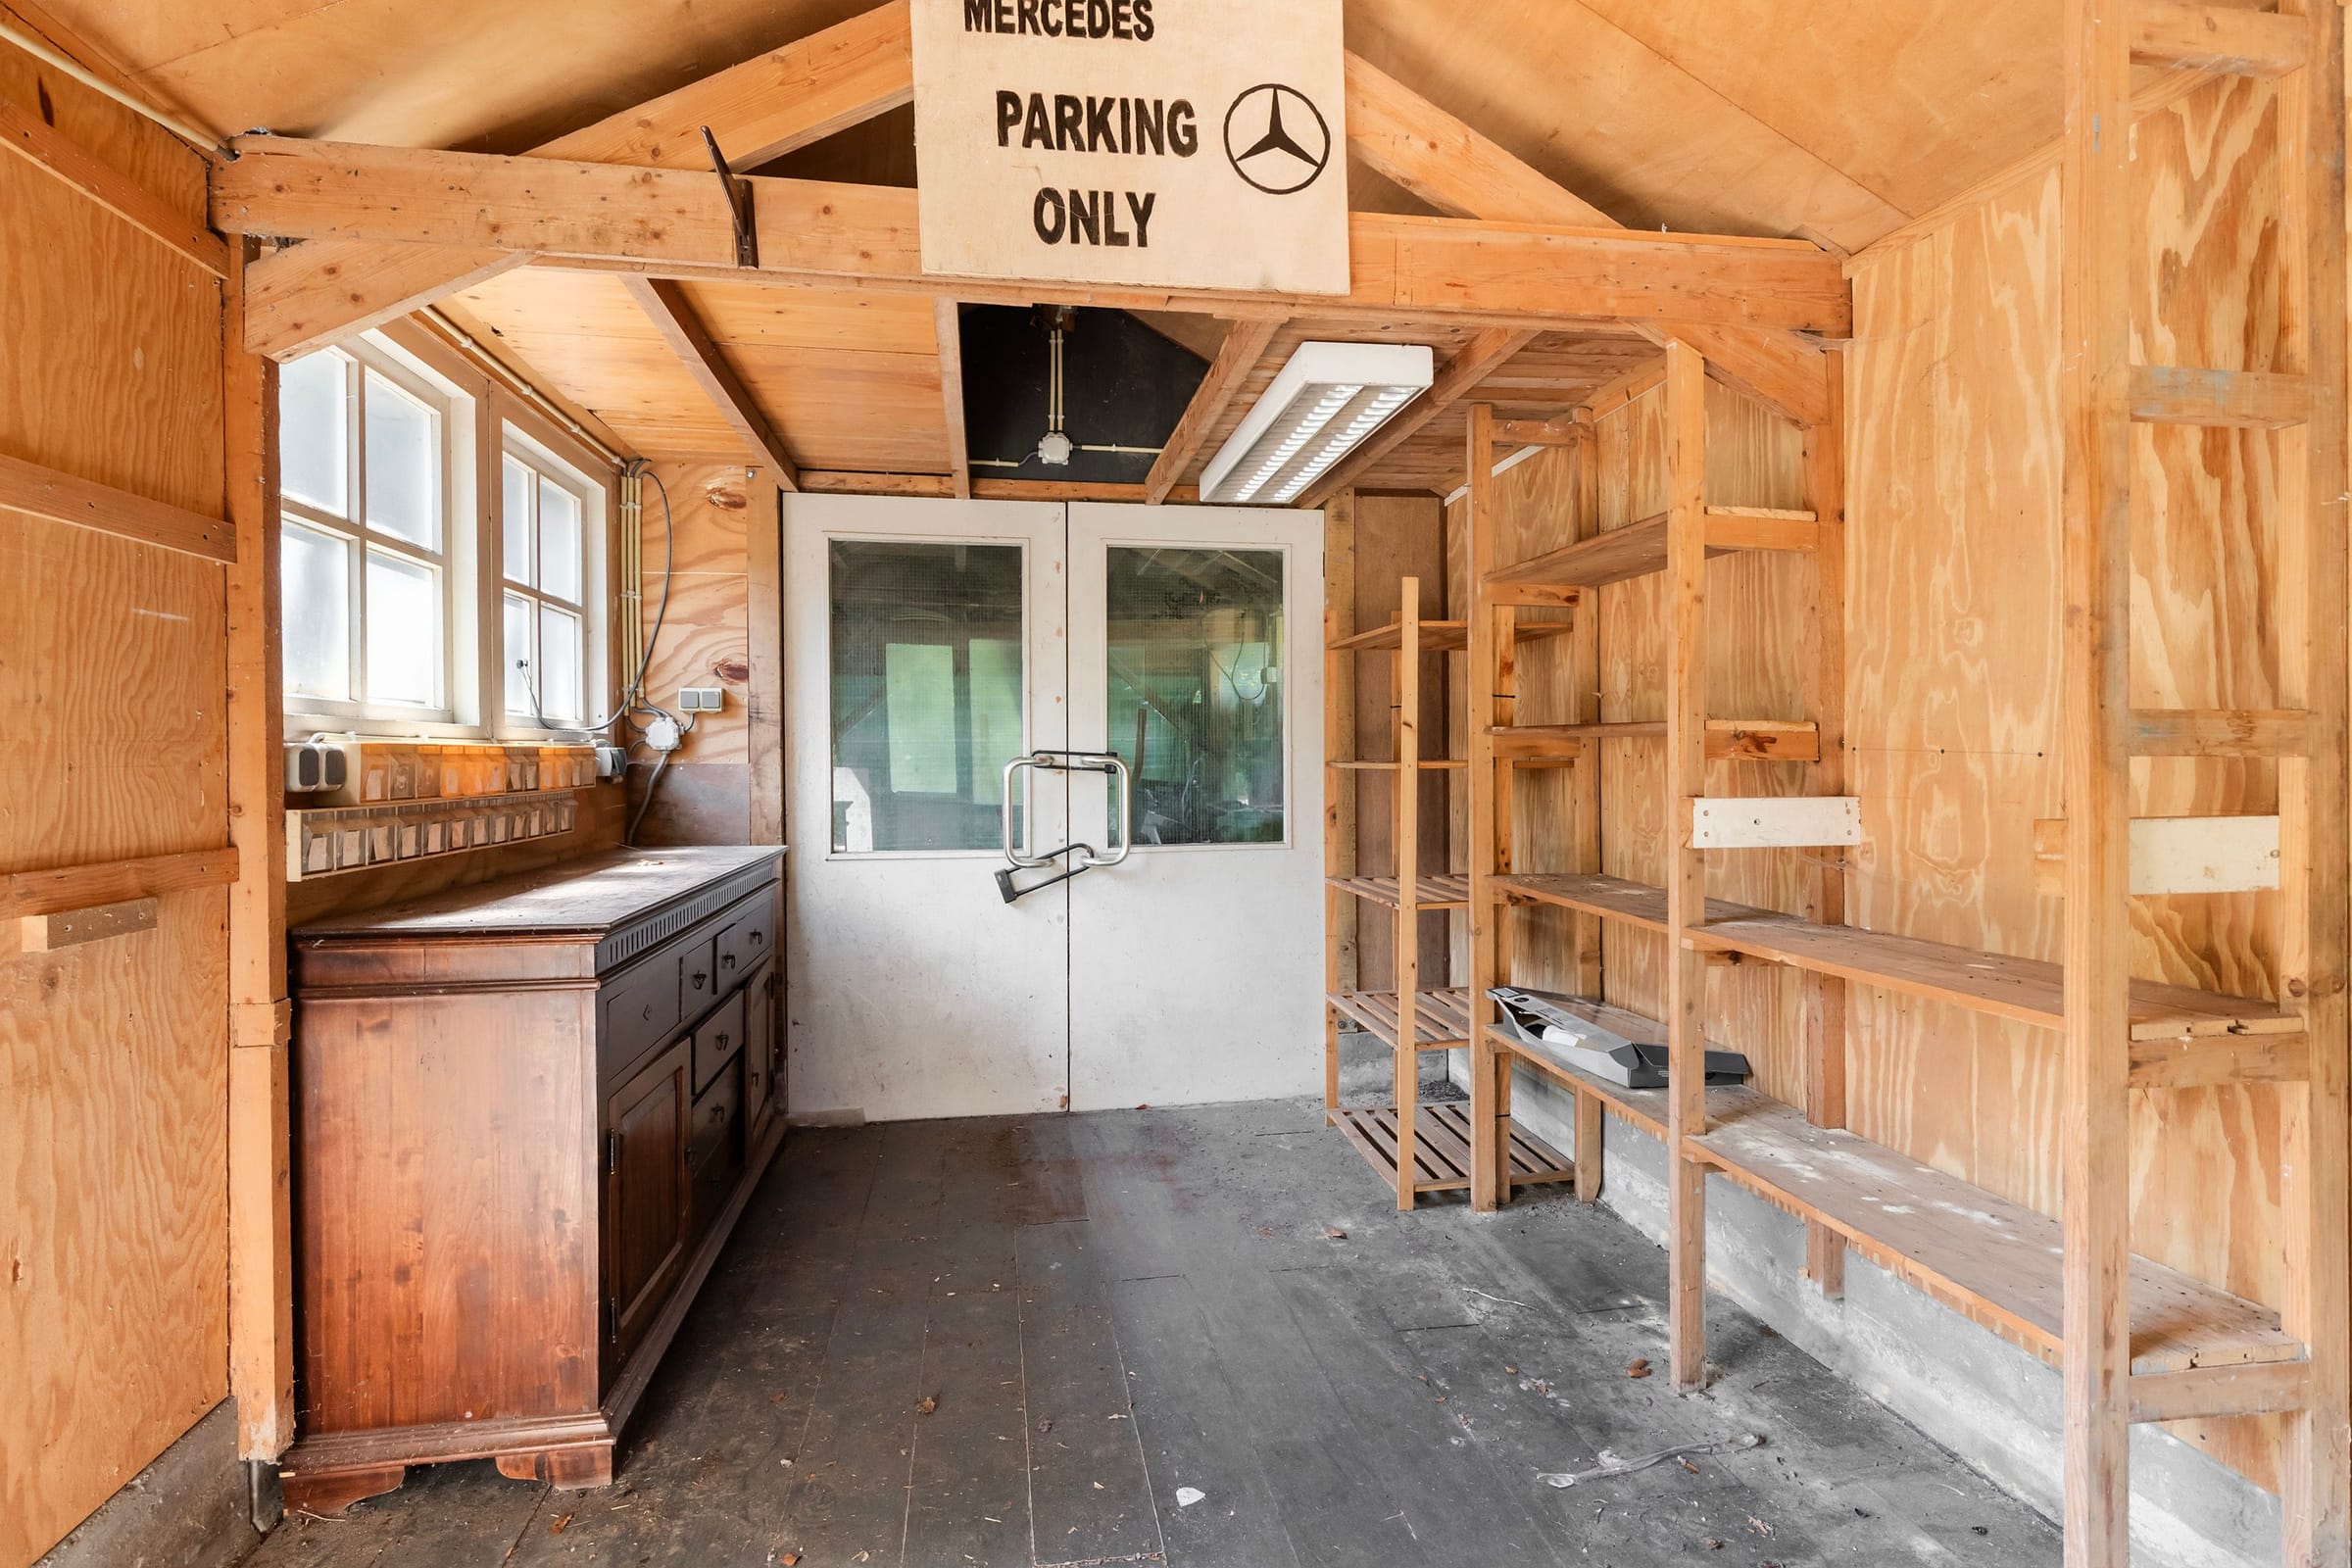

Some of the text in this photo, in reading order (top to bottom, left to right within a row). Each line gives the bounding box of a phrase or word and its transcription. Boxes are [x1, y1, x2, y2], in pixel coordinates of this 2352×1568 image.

[963, 0, 1155, 42] MERCEDES
[996, 89, 1199, 158] PARKING
[1033, 186, 1156, 248] ONLY
